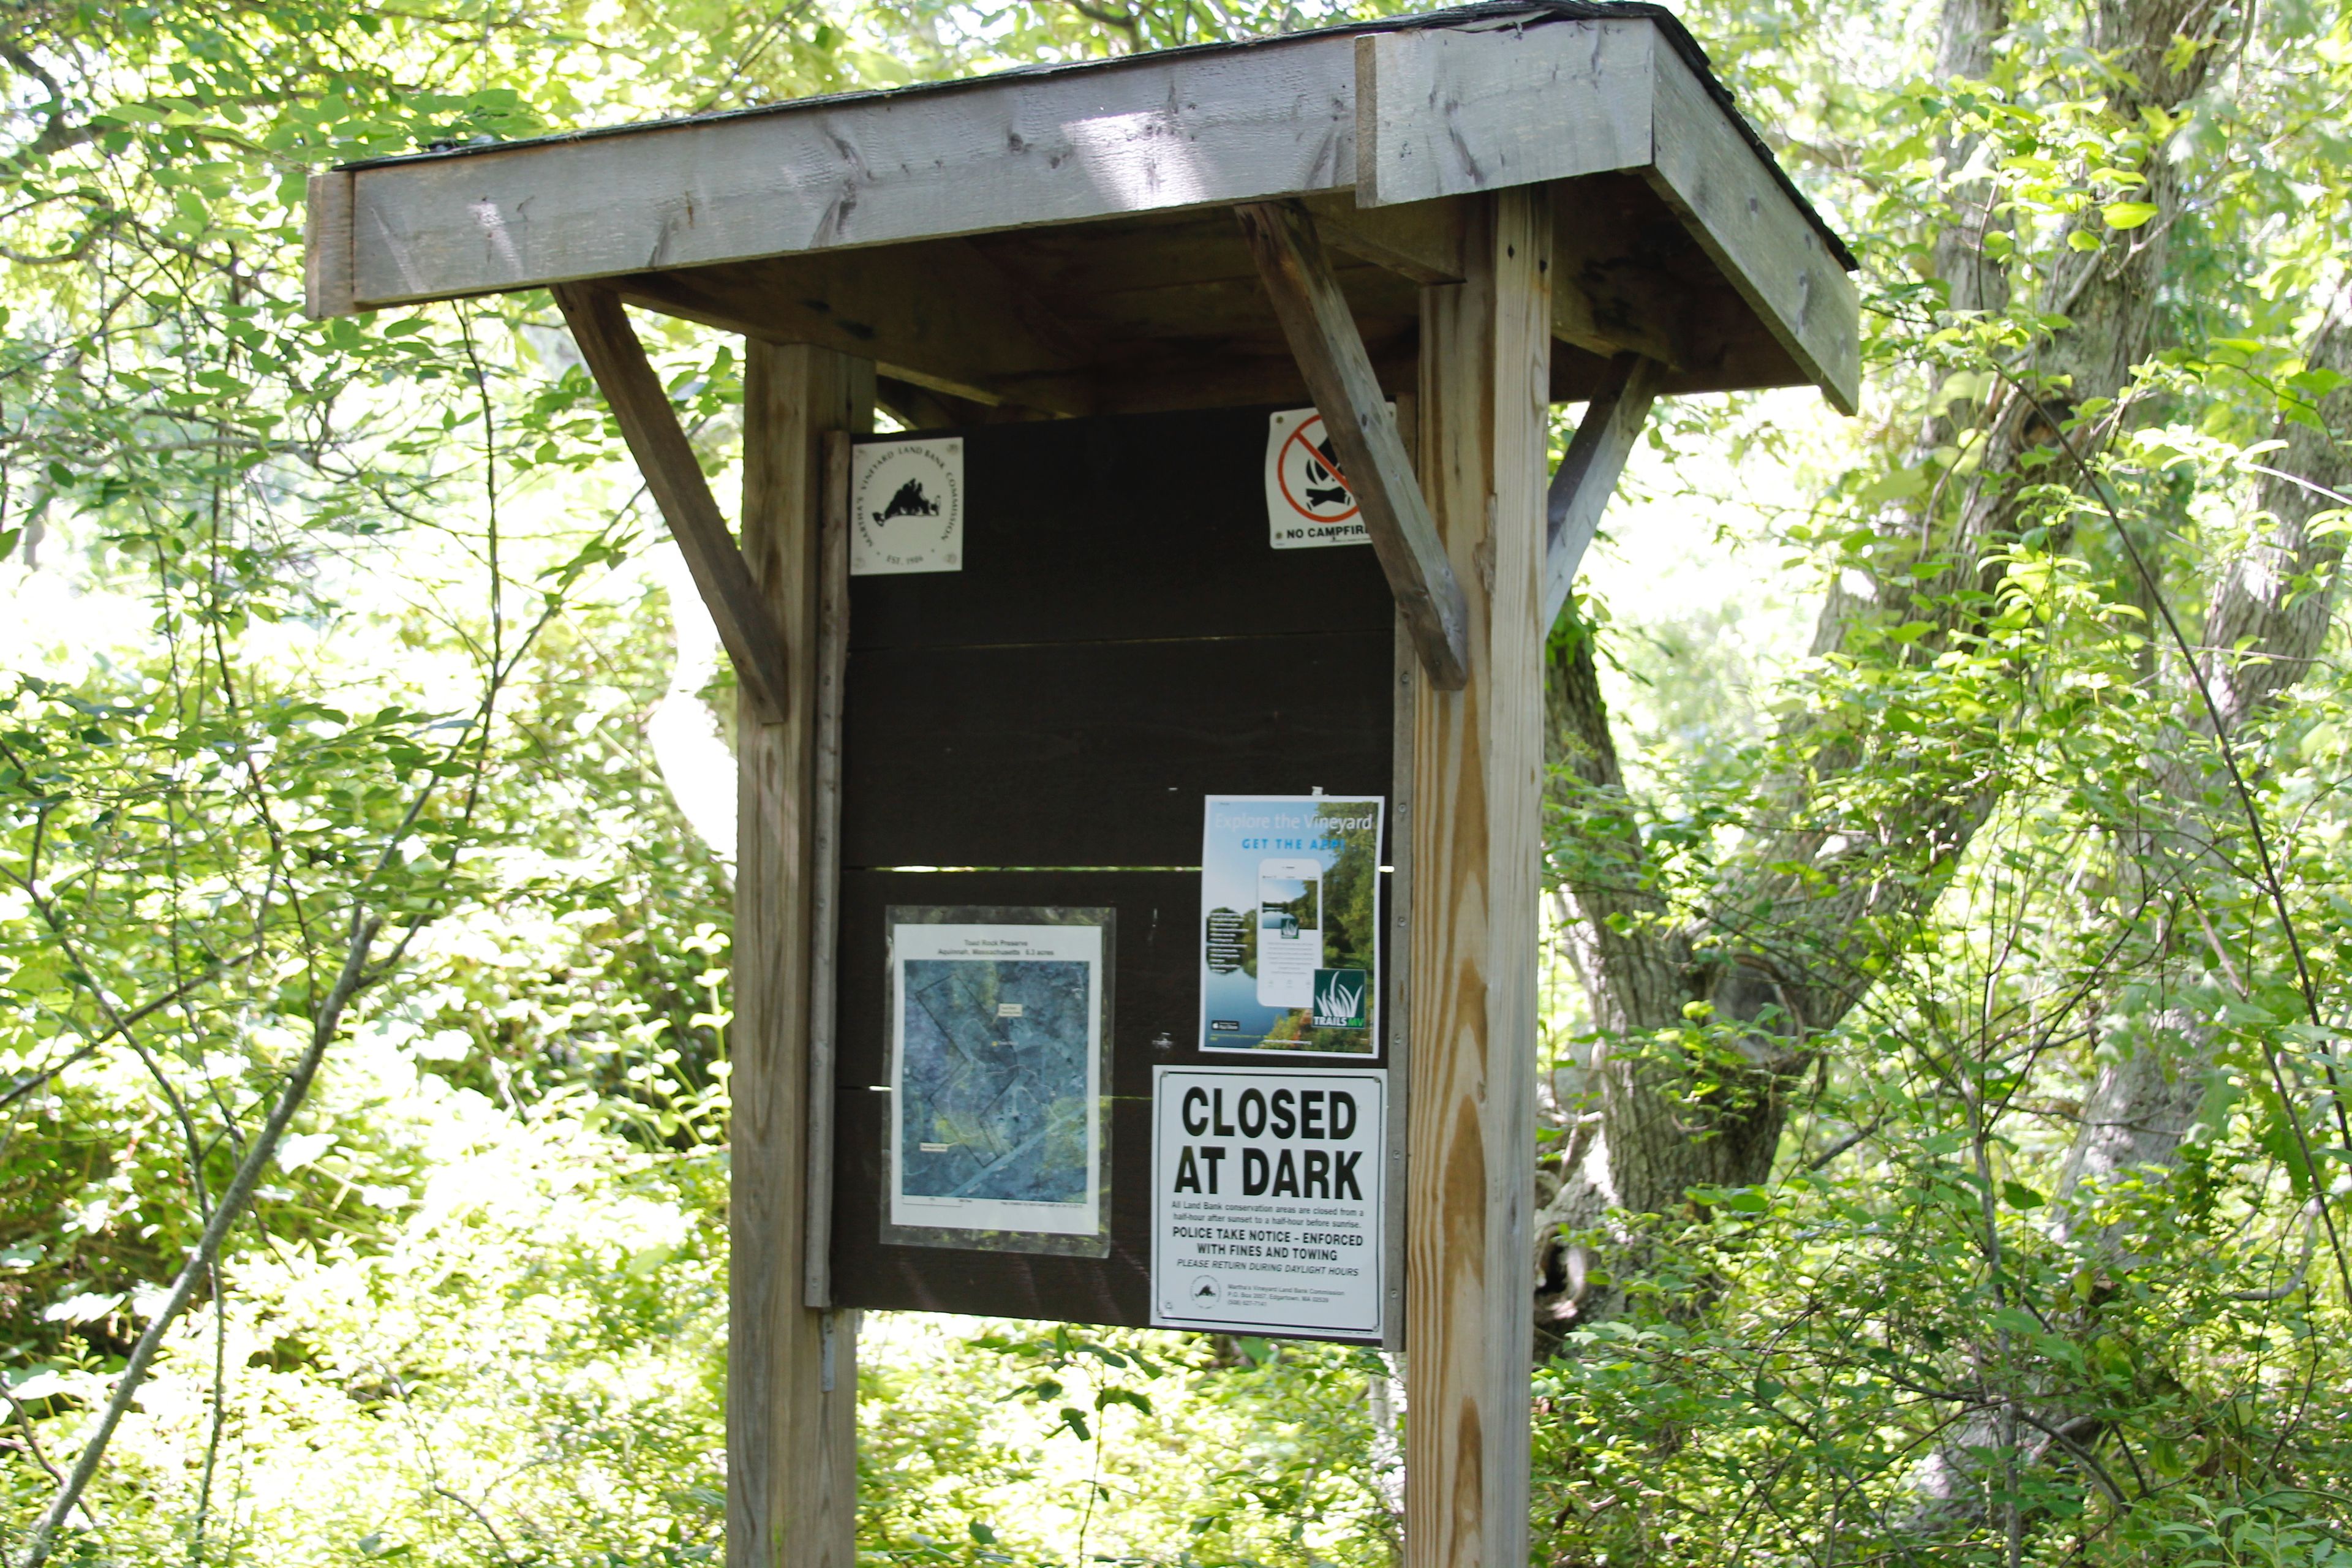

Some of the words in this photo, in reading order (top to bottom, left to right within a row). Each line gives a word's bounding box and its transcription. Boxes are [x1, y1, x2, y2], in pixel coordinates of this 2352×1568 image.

[861, 451, 894, 490] VINEYARD
[898, 447, 922, 455] LAND
[925, 450, 945, 469] BANK
[941, 472, 958, 541] COMMISSION
[1287, 529, 1304, 538] NO
[1308, 525, 1368, 538] CAMPFIR
[1215, 813, 1270, 833] Explore
[1274, 813, 1300, 828] the
[1303, 813, 1373, 834] Vineyard
[1242, 839, 1268, 849] GET
[1276, 839, 1302, 850] THE
[1182, 1086, 1356, 1140] CLOSED
[1174, 1145, 1226, 1194] AT
[1243, 1147, 1363, 1200] DARK
[1225, 1204, 1273, 1212] conservation
[1313, 1207, 1338, 1215] closed
[1340, 1207, 1357, 1216] from
[1173, 1212, 1205, 1221] half-hour
[1207, 1213, 1225, 1222] after
[1272, 1216, 1304, 1225] half-hour
[1306, 1218, 1330, 1227] before
[1332, 1219, 1362, 1229] sunrise.
[1172, 1226, 1212, 1238] POLICE
[1216, 1228, 1245, 1240] TAKE
[1250, 1229, 1291, 1243] NOTICE
[1303, 1232, 1363, 1246] ENFORCED
[1197, 1243, 1225, 1254] WITH
[1230, 1245, 1262, 1257] FINES
[1265, 1246, 1289, 1258] AND
[1292, 1248, 1338, 1261] TOWING
[1177, 1259, 1210, 1268] PLEASE
[1212, 1261, 1246, 1270] RETURN
[1249, 1262, 1283, 1272] DURING
[1284, 1264, 1326, 1274] DAYLIGHT
[1329, 1267, 1359, 1276] HOURS
